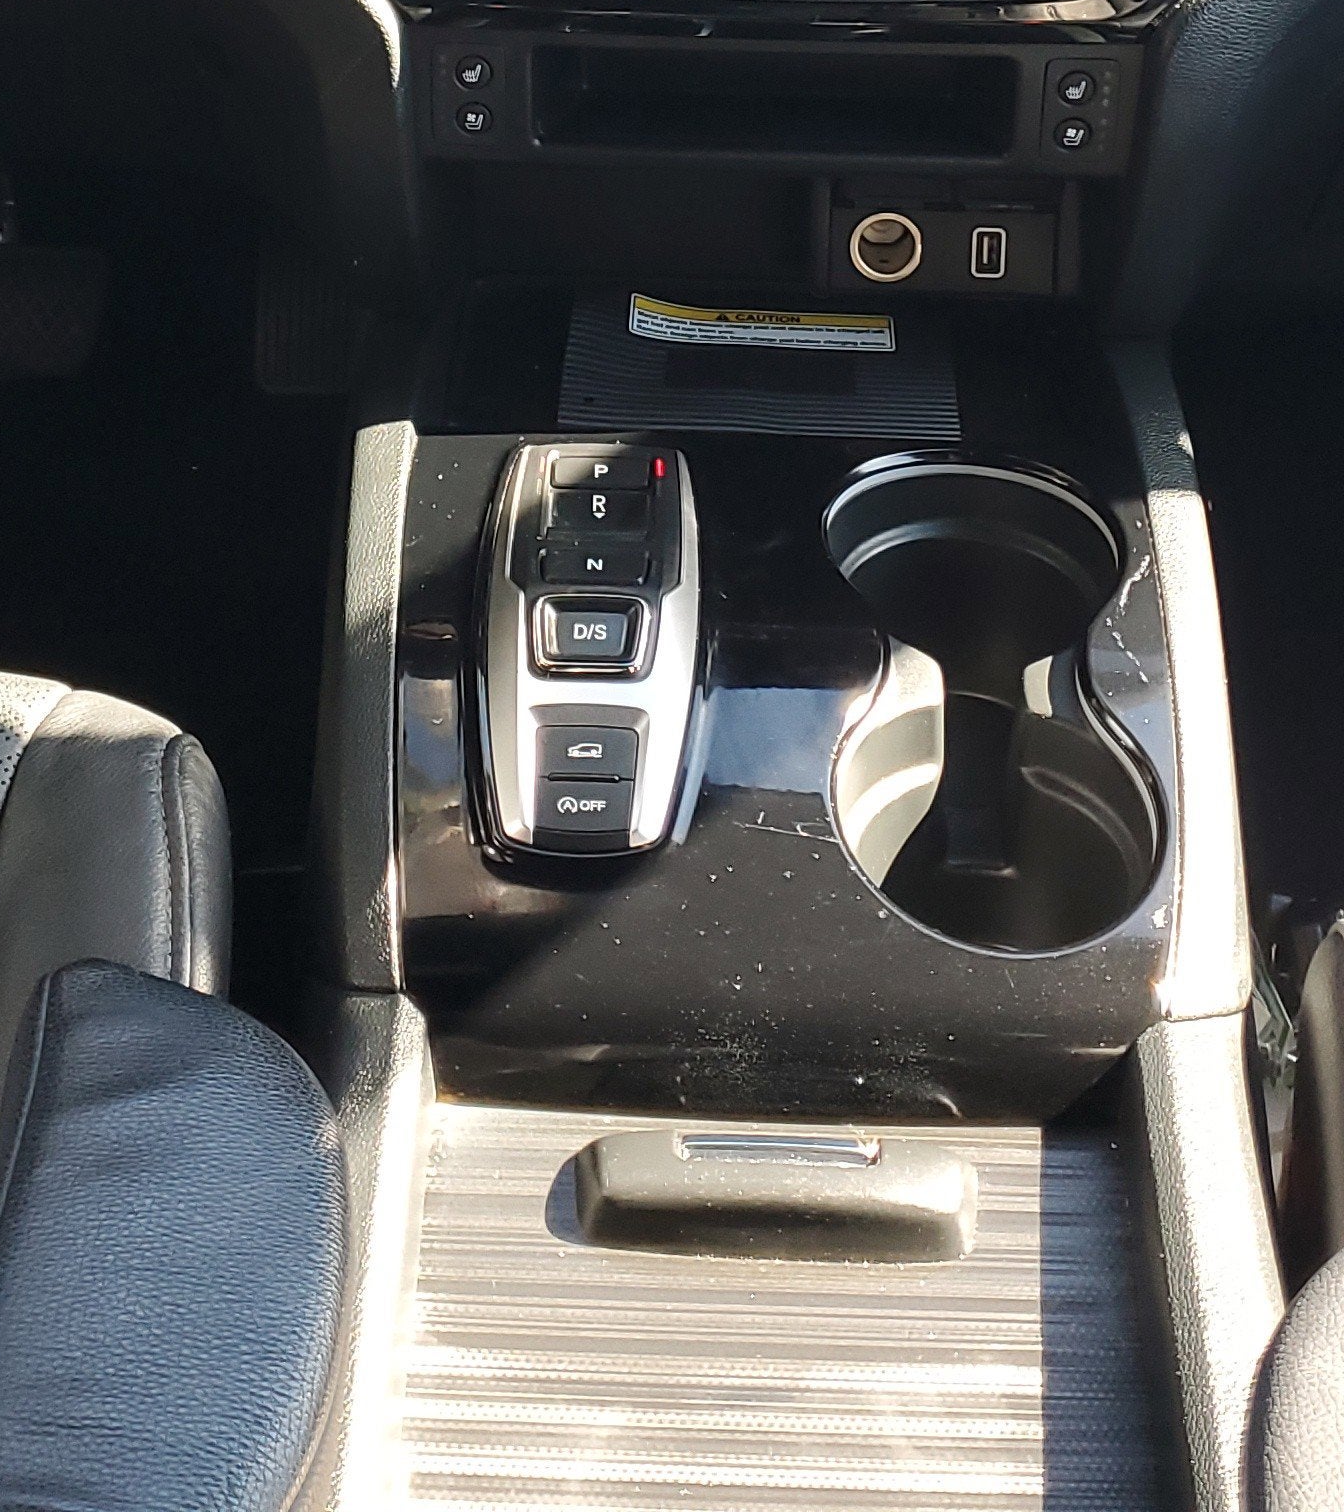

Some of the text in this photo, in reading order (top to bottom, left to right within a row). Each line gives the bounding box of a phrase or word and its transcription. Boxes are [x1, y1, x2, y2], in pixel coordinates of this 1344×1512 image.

[735, 312, 801, 324] CAUTION
[594, 464, 609, 478] P
[592, 494, 607, 512] R
[586, 558, 603, 571] N
[573, 623, 607, 640] D/S
[579, 799, 607, 812] OFF
